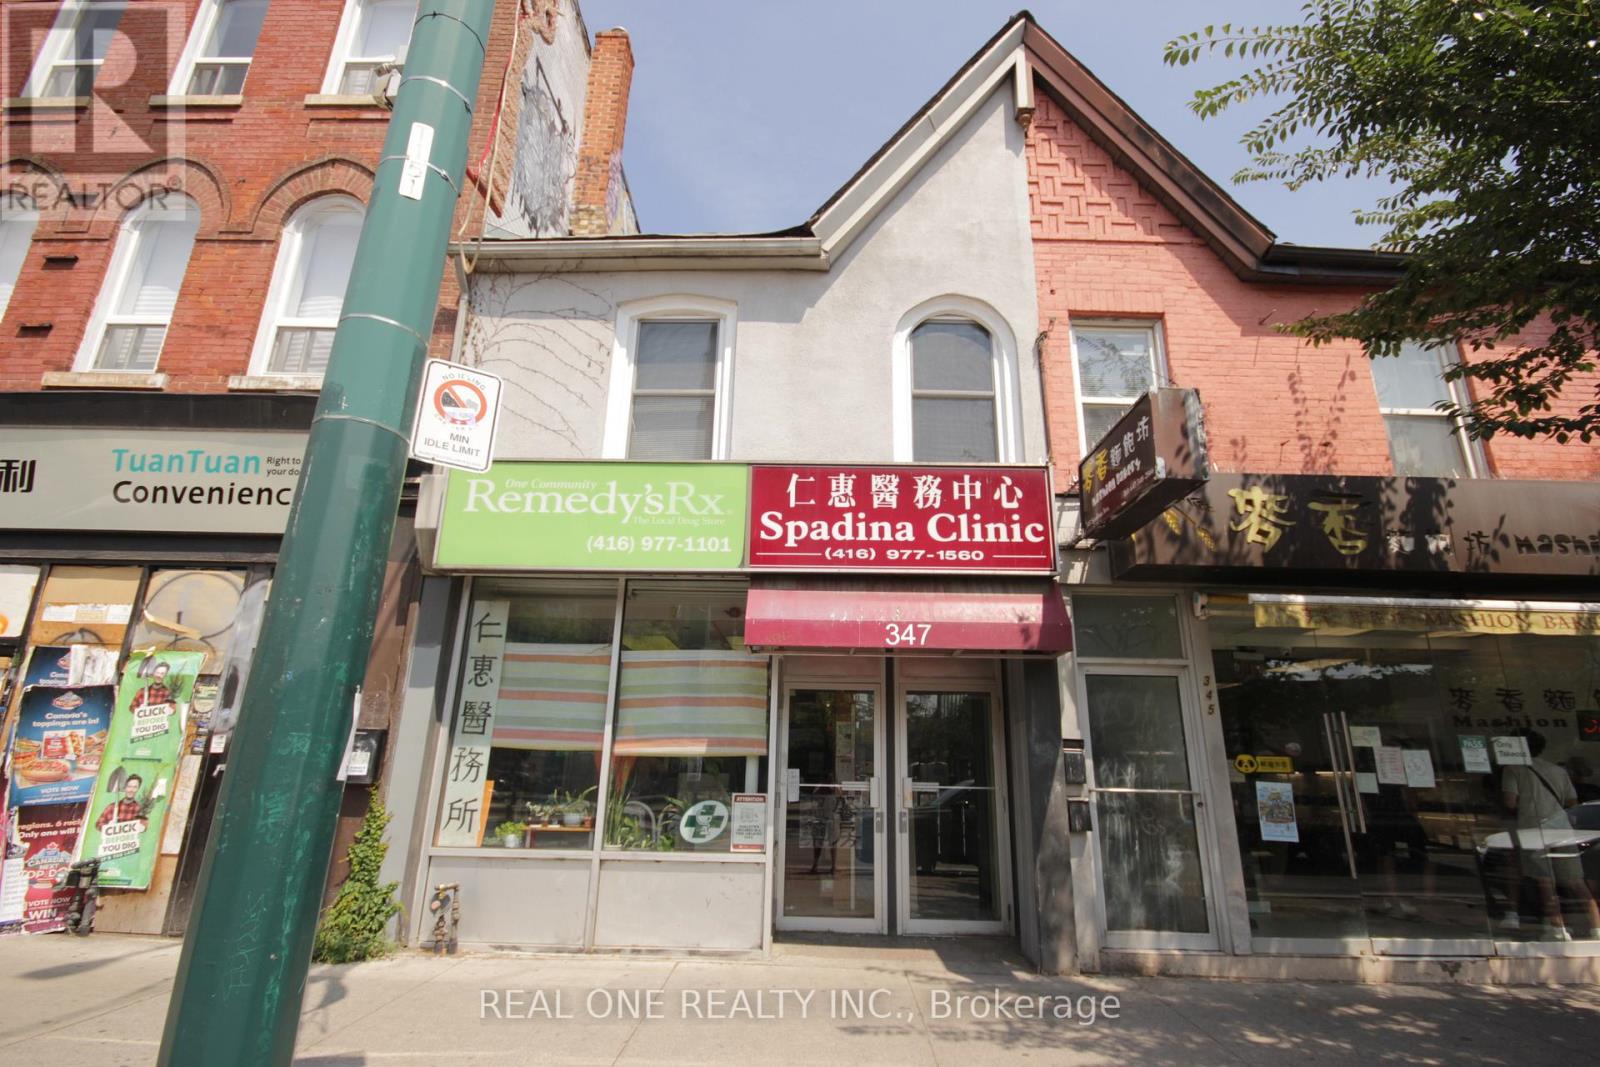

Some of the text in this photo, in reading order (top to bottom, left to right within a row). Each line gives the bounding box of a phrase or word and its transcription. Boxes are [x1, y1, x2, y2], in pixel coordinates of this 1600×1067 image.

[449, 432, 470, 444] MIN
[424, 437, 480, 457] IDLE LIMIT
[112, 448, 261, 475] TuanTuan
[266, 455, 302, 468] Right to
[266, 467, 300, 477] your do
[505, 478, 598, 491] One Community
[112, 480, 292, 506] Convenienc
[786, 473, 1024, 510] 仁惠醫務中心
[651, 516, 674, 525] Local
[760, 511, 1045, 547] Spadina Clinic
[587, 535, 732, 553] (416) 977-1101
[825, 547, 985, 561] (416) 977-1560
[885, 623, 932, 646] 347
[45, 711, 87, 720] Canada's
[137, 706, 167, 719] CLICK
[33, 719, 70, 727] toppings
[134, 725, 150, 736] YOU
[151, 722, 167, 733] DIG
[442, 611, 503, 834] 仁惠醫務所
[18, 822, 54, 831] regions.
[19, 830, 39, 839] Only
[40, 829, 58, 837] one
[60, 827, 76, 835] will
[105, 823, 137, 837] CLICK
[102, 840, 137, 853] YOU DIG
[29, 896, 71, 907] VOTE NOW
[29, 908, 57, 920] WIN
